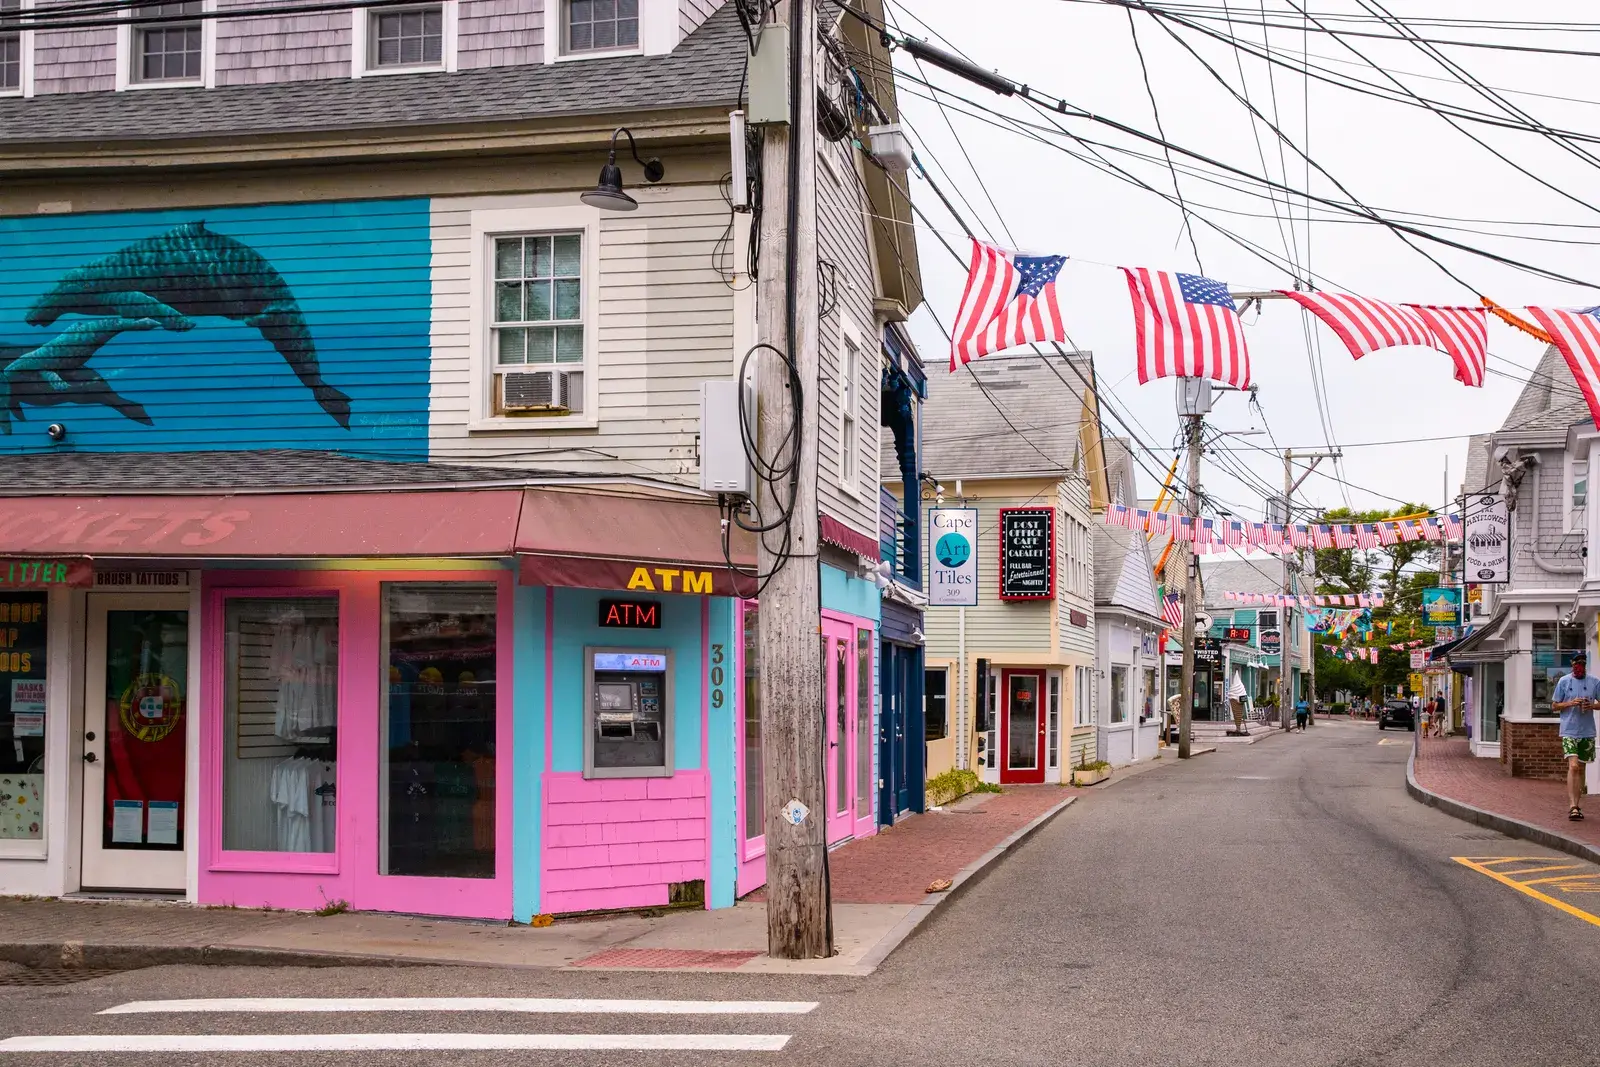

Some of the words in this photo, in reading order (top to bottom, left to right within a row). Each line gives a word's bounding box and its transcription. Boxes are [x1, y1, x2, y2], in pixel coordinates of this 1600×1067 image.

[934, 513, 972, 532] Cape
[1013, 521, 1039, 529] POST
[1467, 514, 1507, 527] MAYFLOWER
[1009, 529, 1044, 537] OFFICE
[1013, 537, 1040, 545] CAFE
[939, 540, 969, 556] Art
[1009, 549, 1044, 557] CABARET
[1466, 556, 1482, 567] FOOD
[1488, 556, 1507, 567] DRINK
[97, 572, 132, 585] BRUSH
[136, 572, 179, 585] TATTOOS
[627, 567, 714, 594] ATM
[935, 570, 972, 585] Tiles
[1008, 569, 1045, 584] Entertainment
[947, 589, 960, 598] 309
[606, 604, 655, 626] ATM
[632, 658, 660, 667] ATM
[711, 644, 724, 709] 309
[17, 683, 43, 692] MASKS
